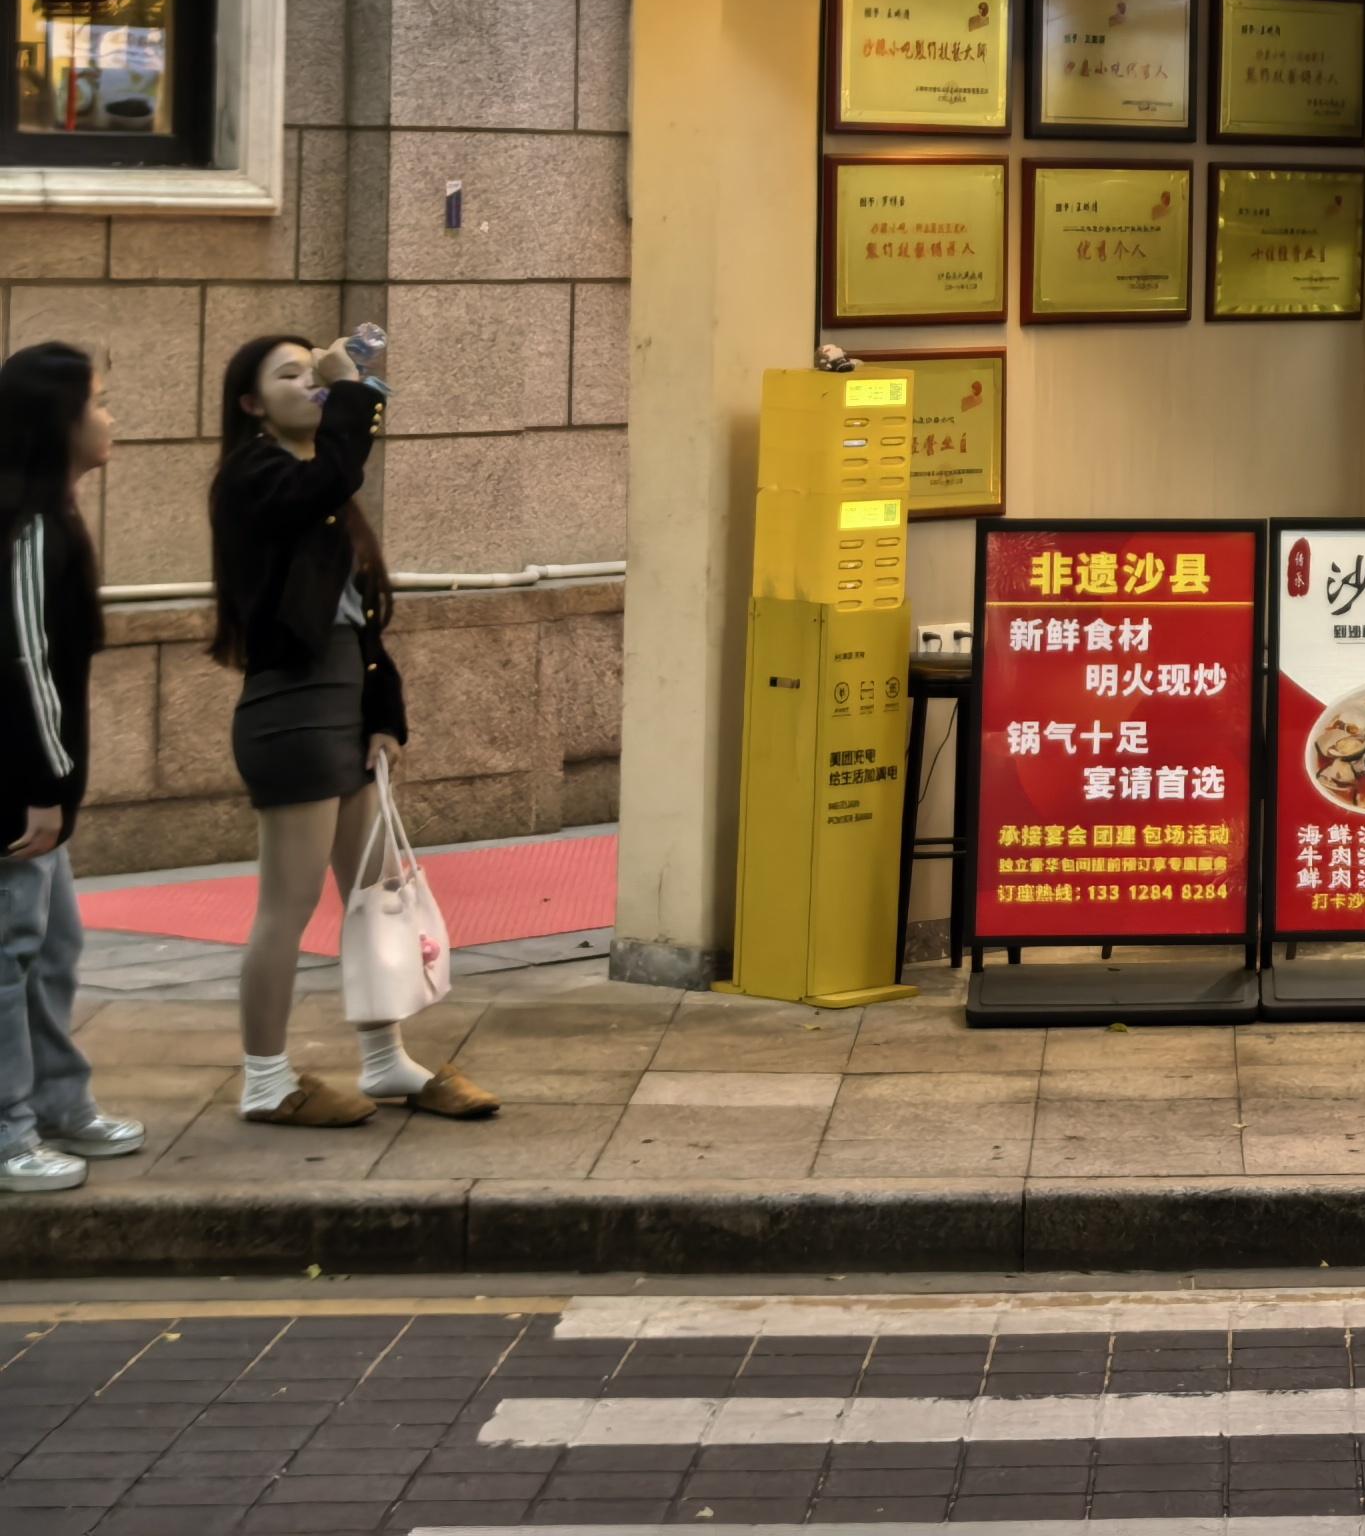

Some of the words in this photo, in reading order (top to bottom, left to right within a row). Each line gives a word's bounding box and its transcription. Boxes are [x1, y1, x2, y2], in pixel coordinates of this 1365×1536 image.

[1030, 550, 1211, 596] 非遗沙县
[1009, 617, 1153, 653] 新鲜食材
[1085, 662, 1228, 697] 明火现炒
[1007, 720, 1150, 756] 锅气十足
[1083, 765, 1226, 801] 宴请首选
[998, 824, 1088, 847] 承接宴会
[1093, 824, 1137, 847] 团建
[1142, 824, 1230, 846] 包场活动
[1088, 884, 1120, 901] 133
[1129, 884, 1173, 901] 1284
[1181, 883, 1228, 901] 8284
